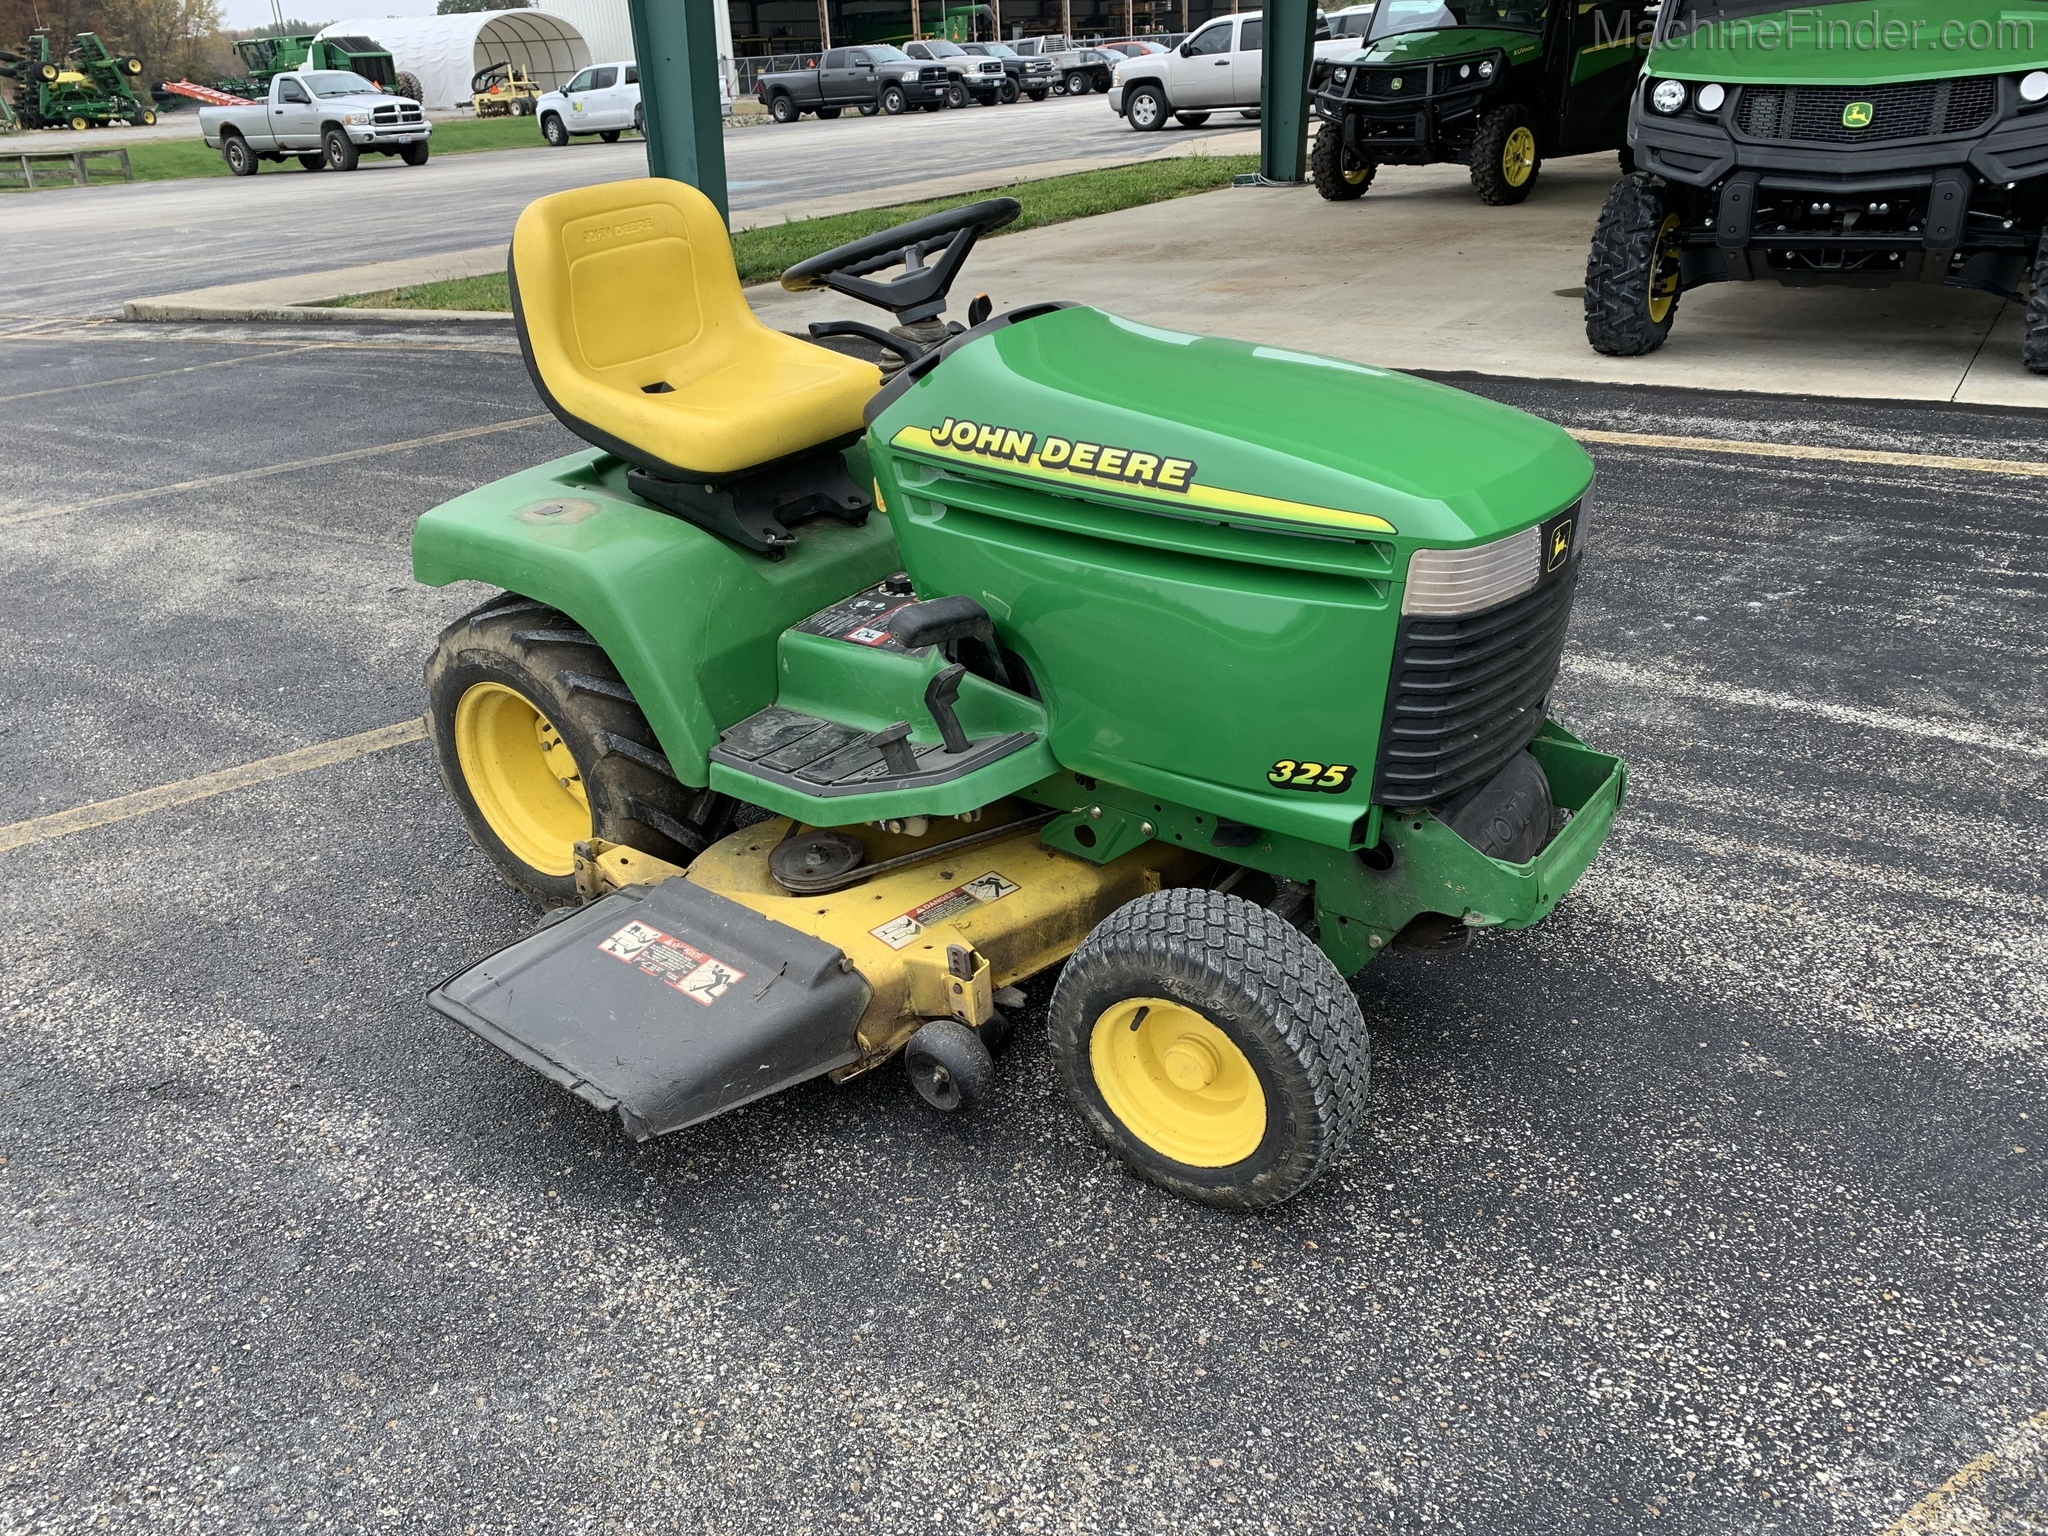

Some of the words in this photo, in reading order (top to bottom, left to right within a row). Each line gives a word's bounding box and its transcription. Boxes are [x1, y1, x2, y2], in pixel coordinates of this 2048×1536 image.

[583, 227, 613, 242] JOHN
[614, 217, 653, 236] DEERE
[930, 416, 1038, 464] JOHN
[1038, 434, 1199, 494] DEERE
[1266, 758, 1358, 795] 325
[923, 891, 957, 910] DANGER
